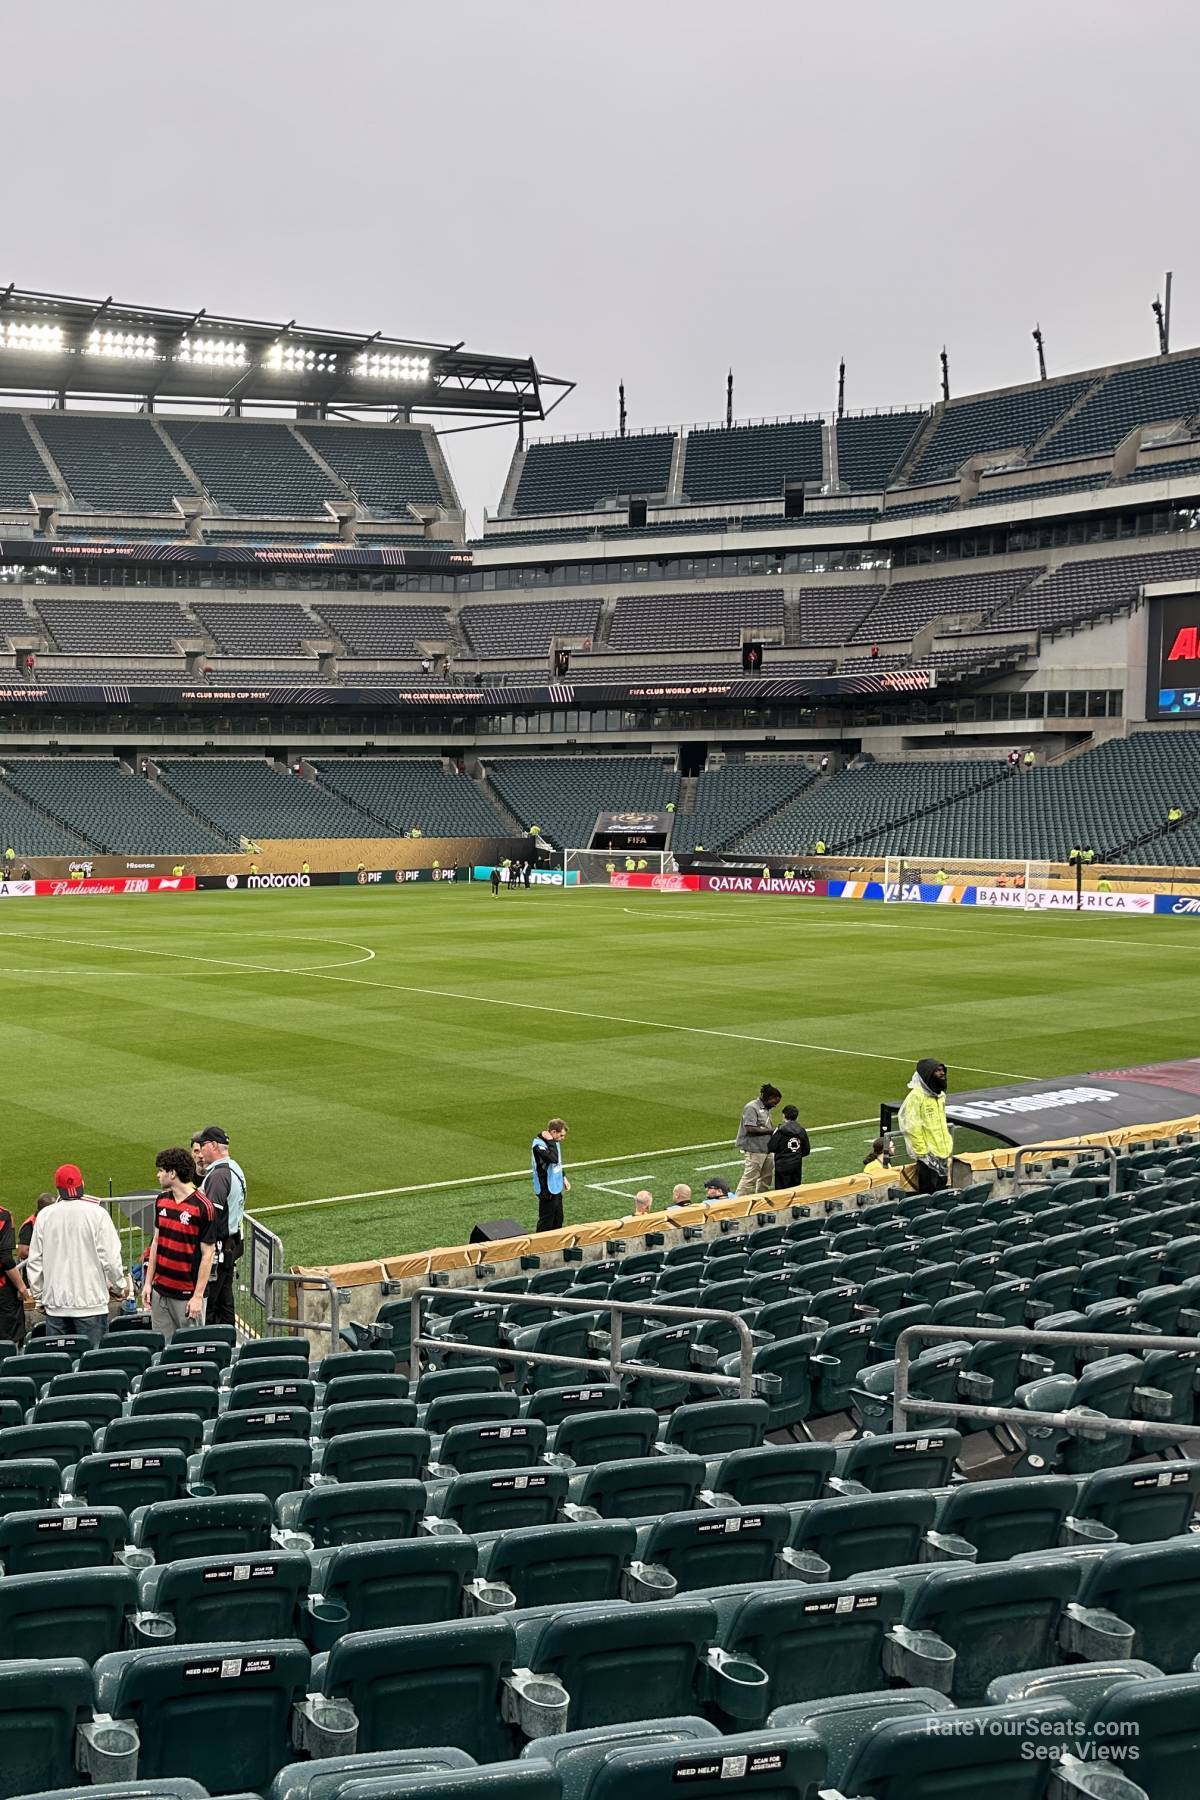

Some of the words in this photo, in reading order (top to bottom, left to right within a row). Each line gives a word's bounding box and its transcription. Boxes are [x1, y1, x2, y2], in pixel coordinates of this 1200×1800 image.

[627, 836, 647, 844] FIFA
[247, 873, 310, 888] motorola
[367, 872, 382, 882] PIF
[405, 870, 419, 881] PIF
[50, 881, 115, 895] Budweiser
[123, 879, 150, 892] ZERO
[708, 876, 752, 892] QATAR
[758, 878, 816, 894] AIRWAYS
[879, 883, 921, 901] VISA
[980, 890, 1020, 903] BANK
[1026, 892, 1045, 904] OF
[1050, 893, 1126, 908] AMERICA
[964, 1087, 1120, 1114] Flamengo
[677, 1768, 696, 1776] NEED
[697, 1766, 719, 1774] HELP?
[750, 1761, 782, 1771] ASSISTANCE
